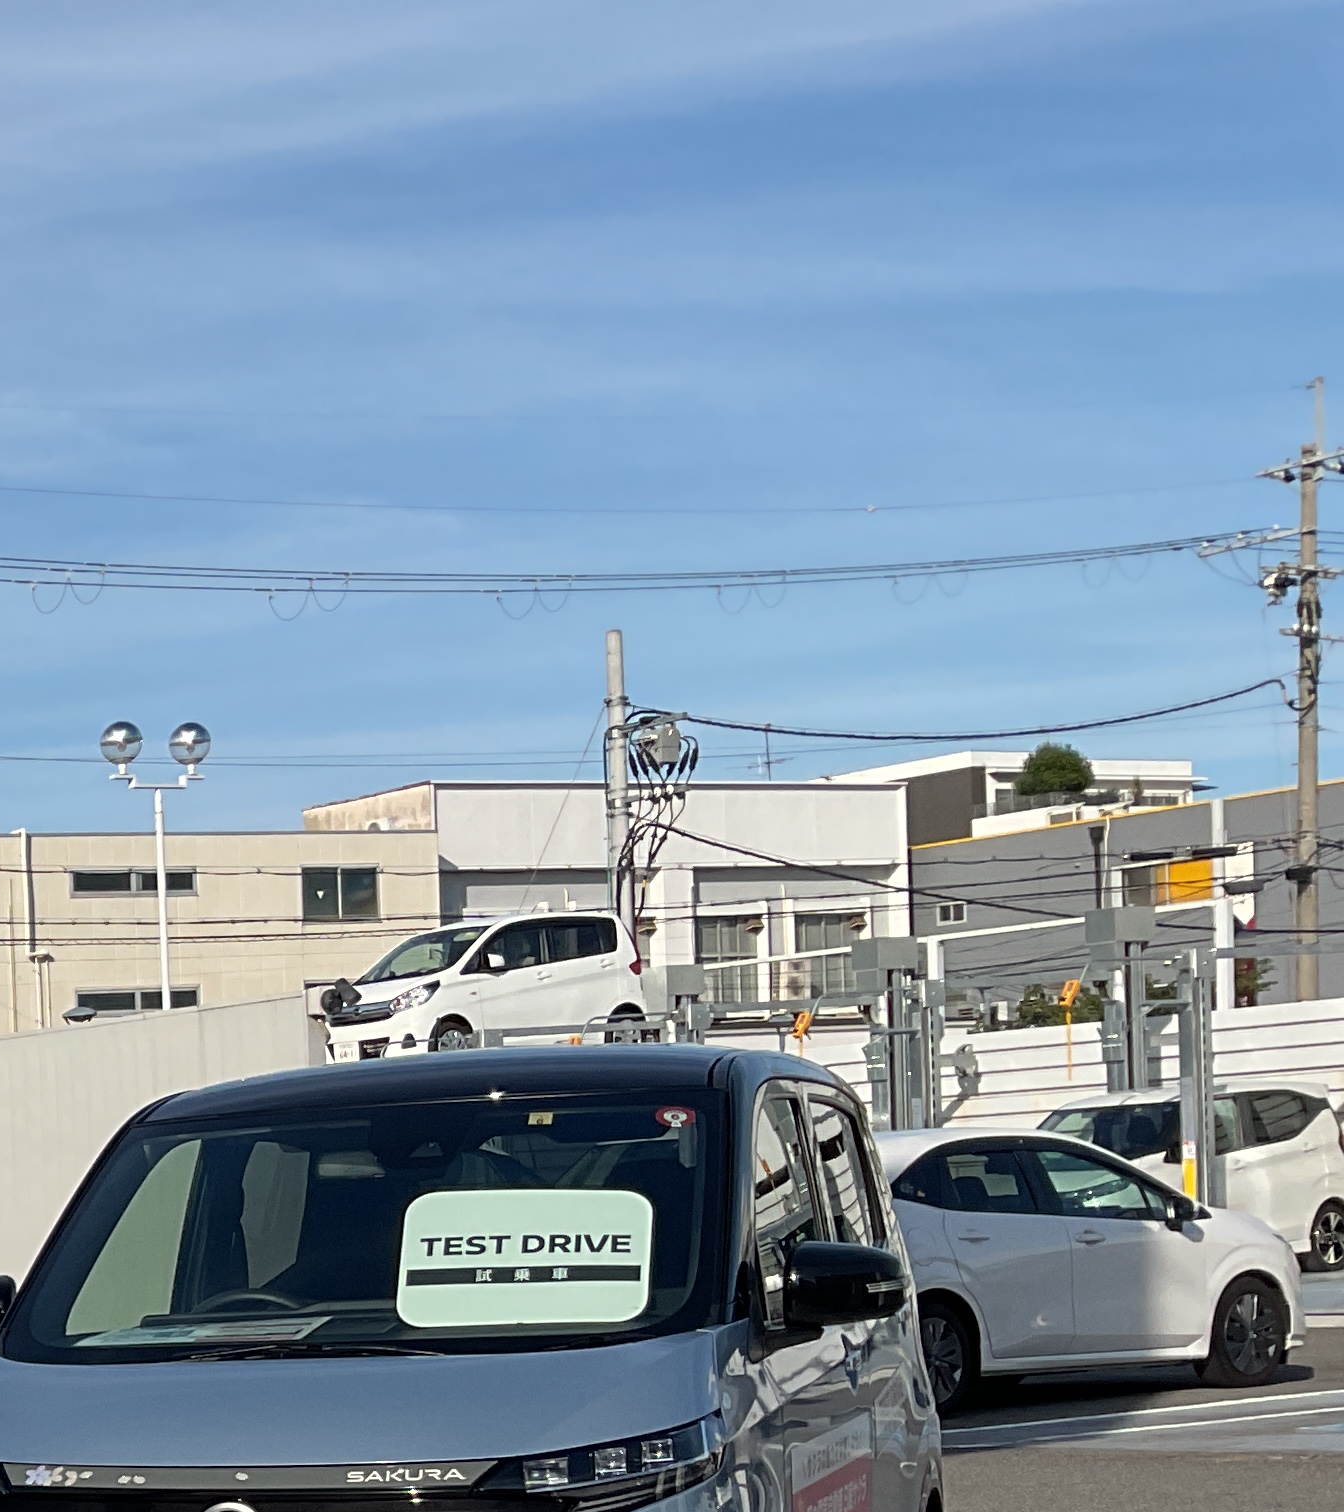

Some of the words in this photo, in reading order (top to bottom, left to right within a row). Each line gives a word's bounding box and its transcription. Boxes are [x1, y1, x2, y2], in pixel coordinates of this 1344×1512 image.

[420, 1235, 511, 1257] TEST
[521, 1234, 632, 1254] DRIVE
[475, 1267, 569, 1283] 試乗車
[346, 1468, 467, 1483] SAKURA
